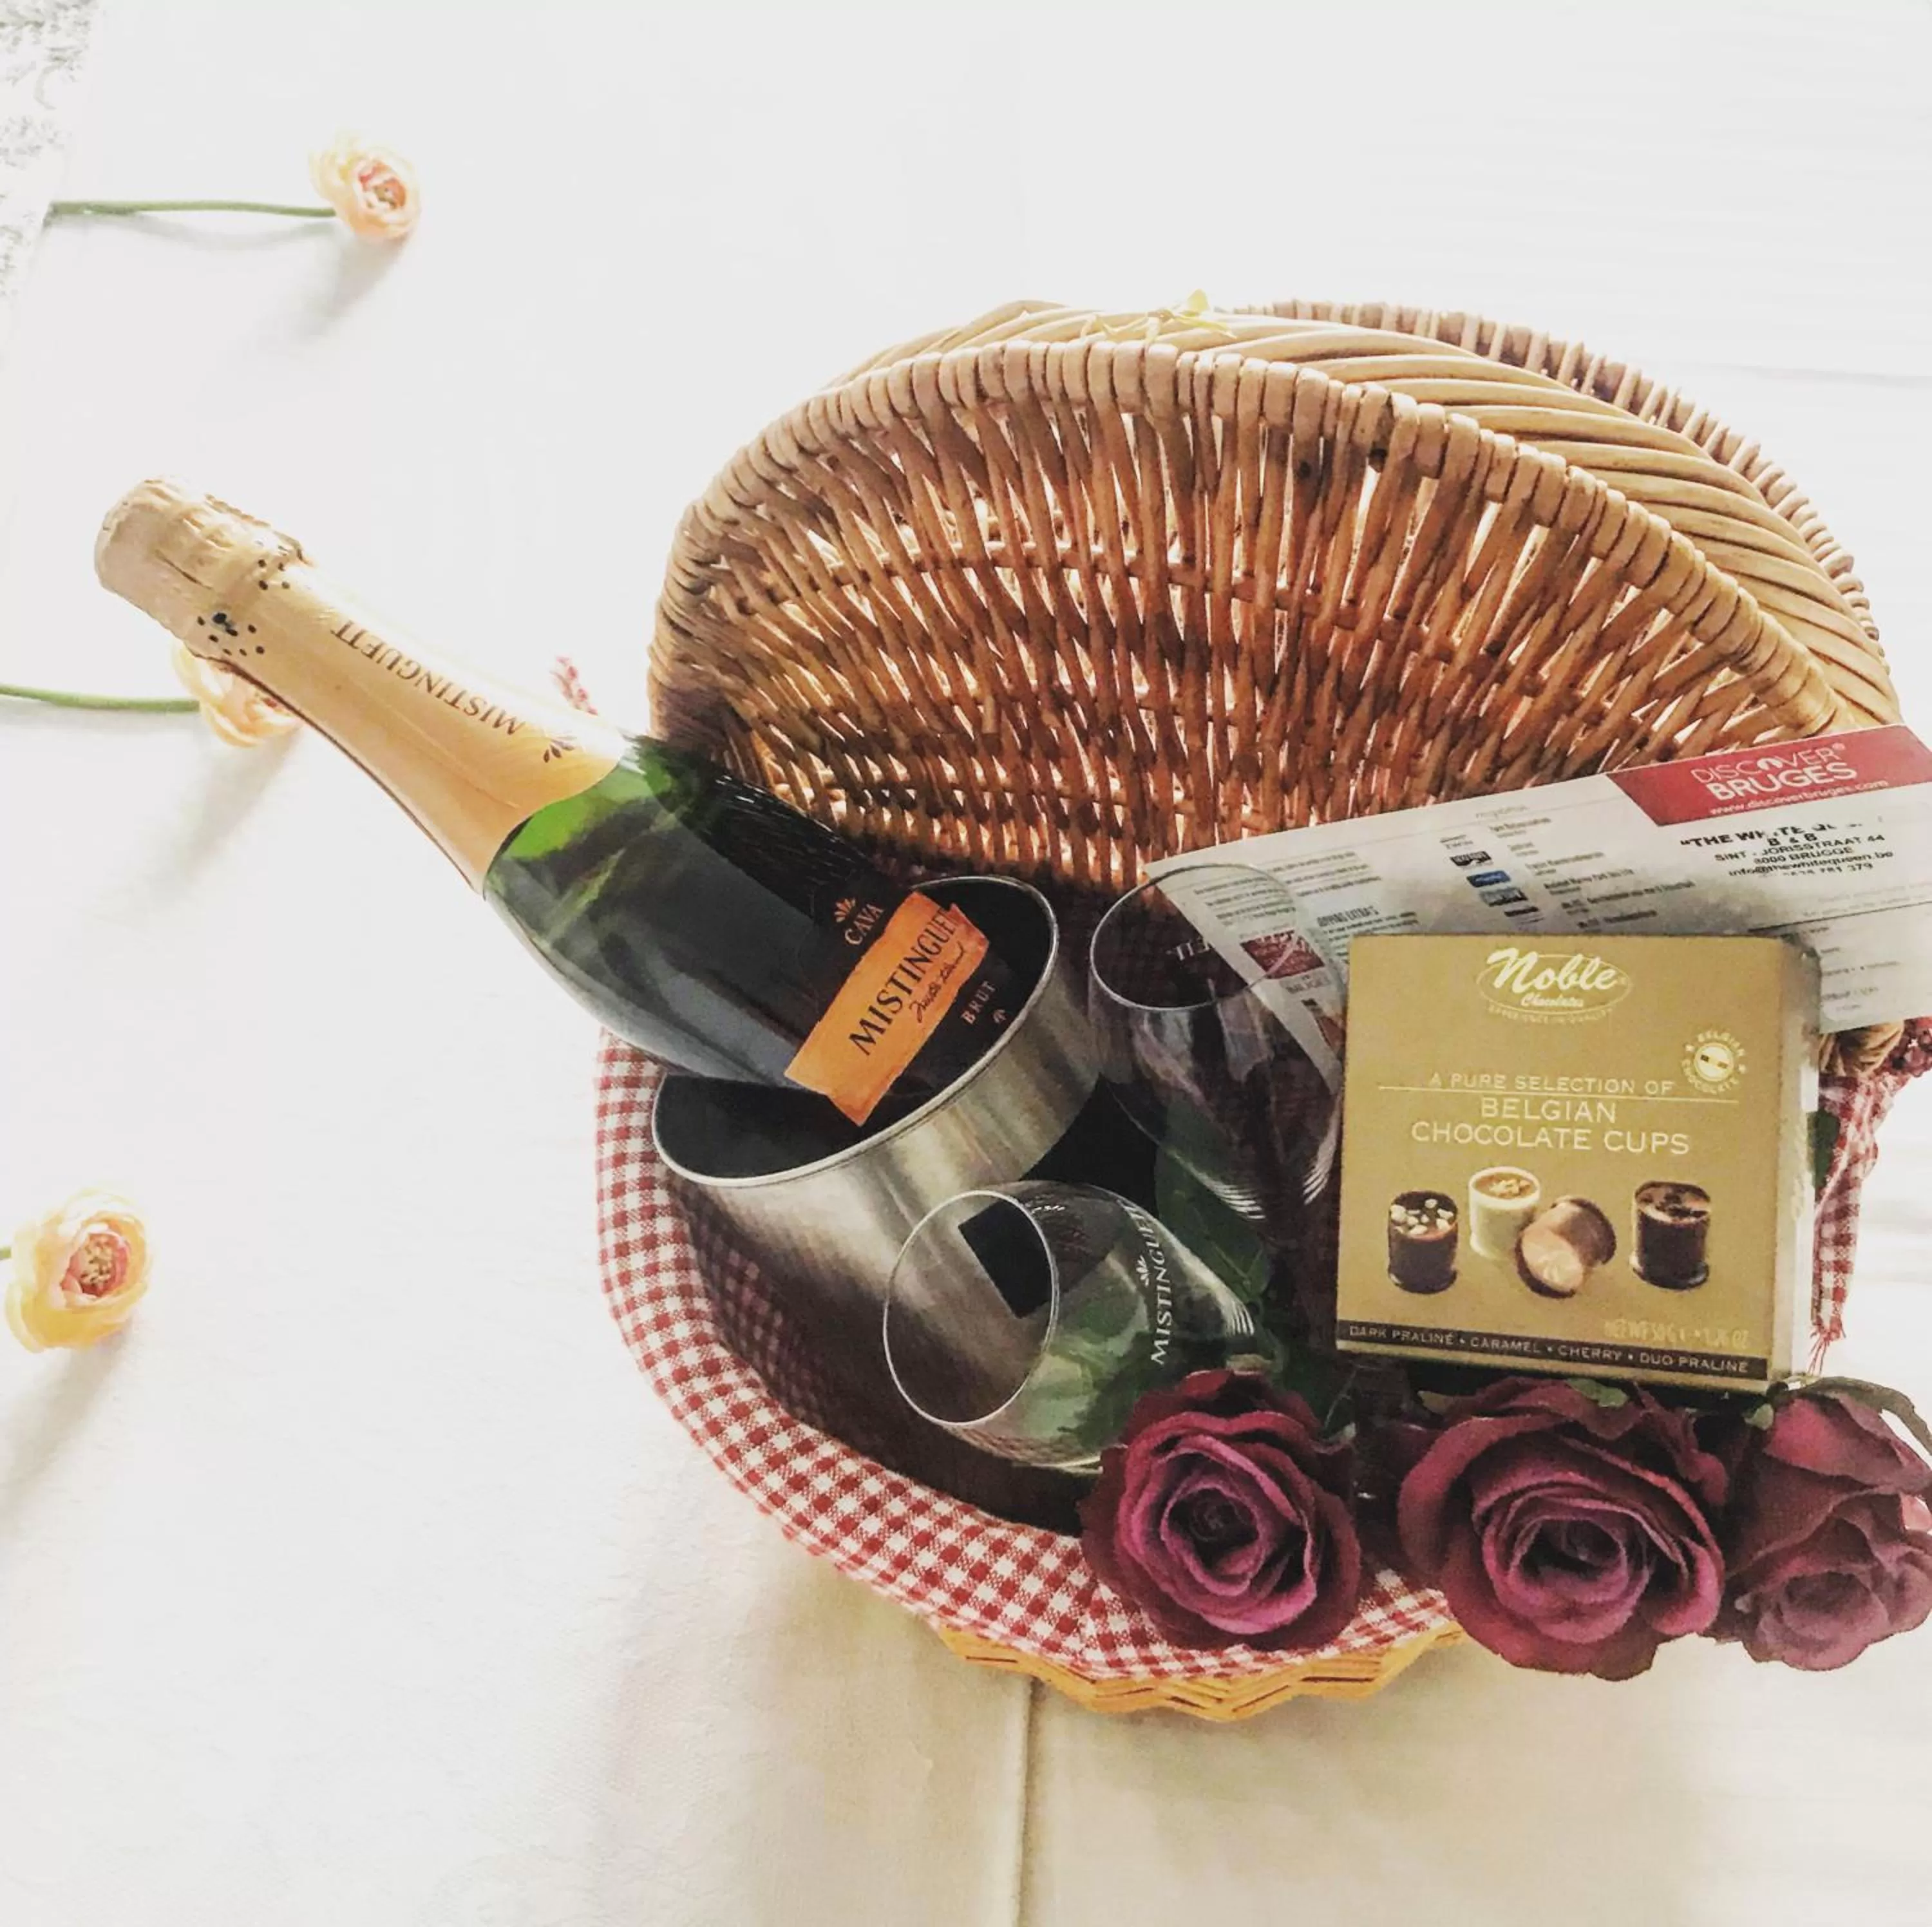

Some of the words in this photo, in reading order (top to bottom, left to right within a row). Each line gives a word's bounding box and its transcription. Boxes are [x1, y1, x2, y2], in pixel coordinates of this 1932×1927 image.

[329, 619, 526, 736] MISTINGUETT
[1691, 746, 1842, 784] DISCOVER
[1706, 762, 1858, 801] BRUGES
[844, 903, 884, 945] CAVA
[1486, 947, 1618, 994] Noble
[961, 980, 997, 1025] BRUT
[1429, 1072, 1443, 1088] A
[1450, 1073, 1506, 1090] PURE
[1515, 1076, 1636, 1094] SELECTION
[1644, 1081, 1675, 1095] OF
[1481, 1097, 1617, 1124] BELGIAN
[1411, 1121, 1593, 1151] CHOCOLATE
[1603, 1130, 1690, 1155] CUPS
[1349, 1325, 1387, 1339] DARK
[1470, 1336, 1541, 1353] CARAMEL
[1557, 1345, 1622, 1362] CHERRY
[1640, 1352, 1674, 1367] DUO
